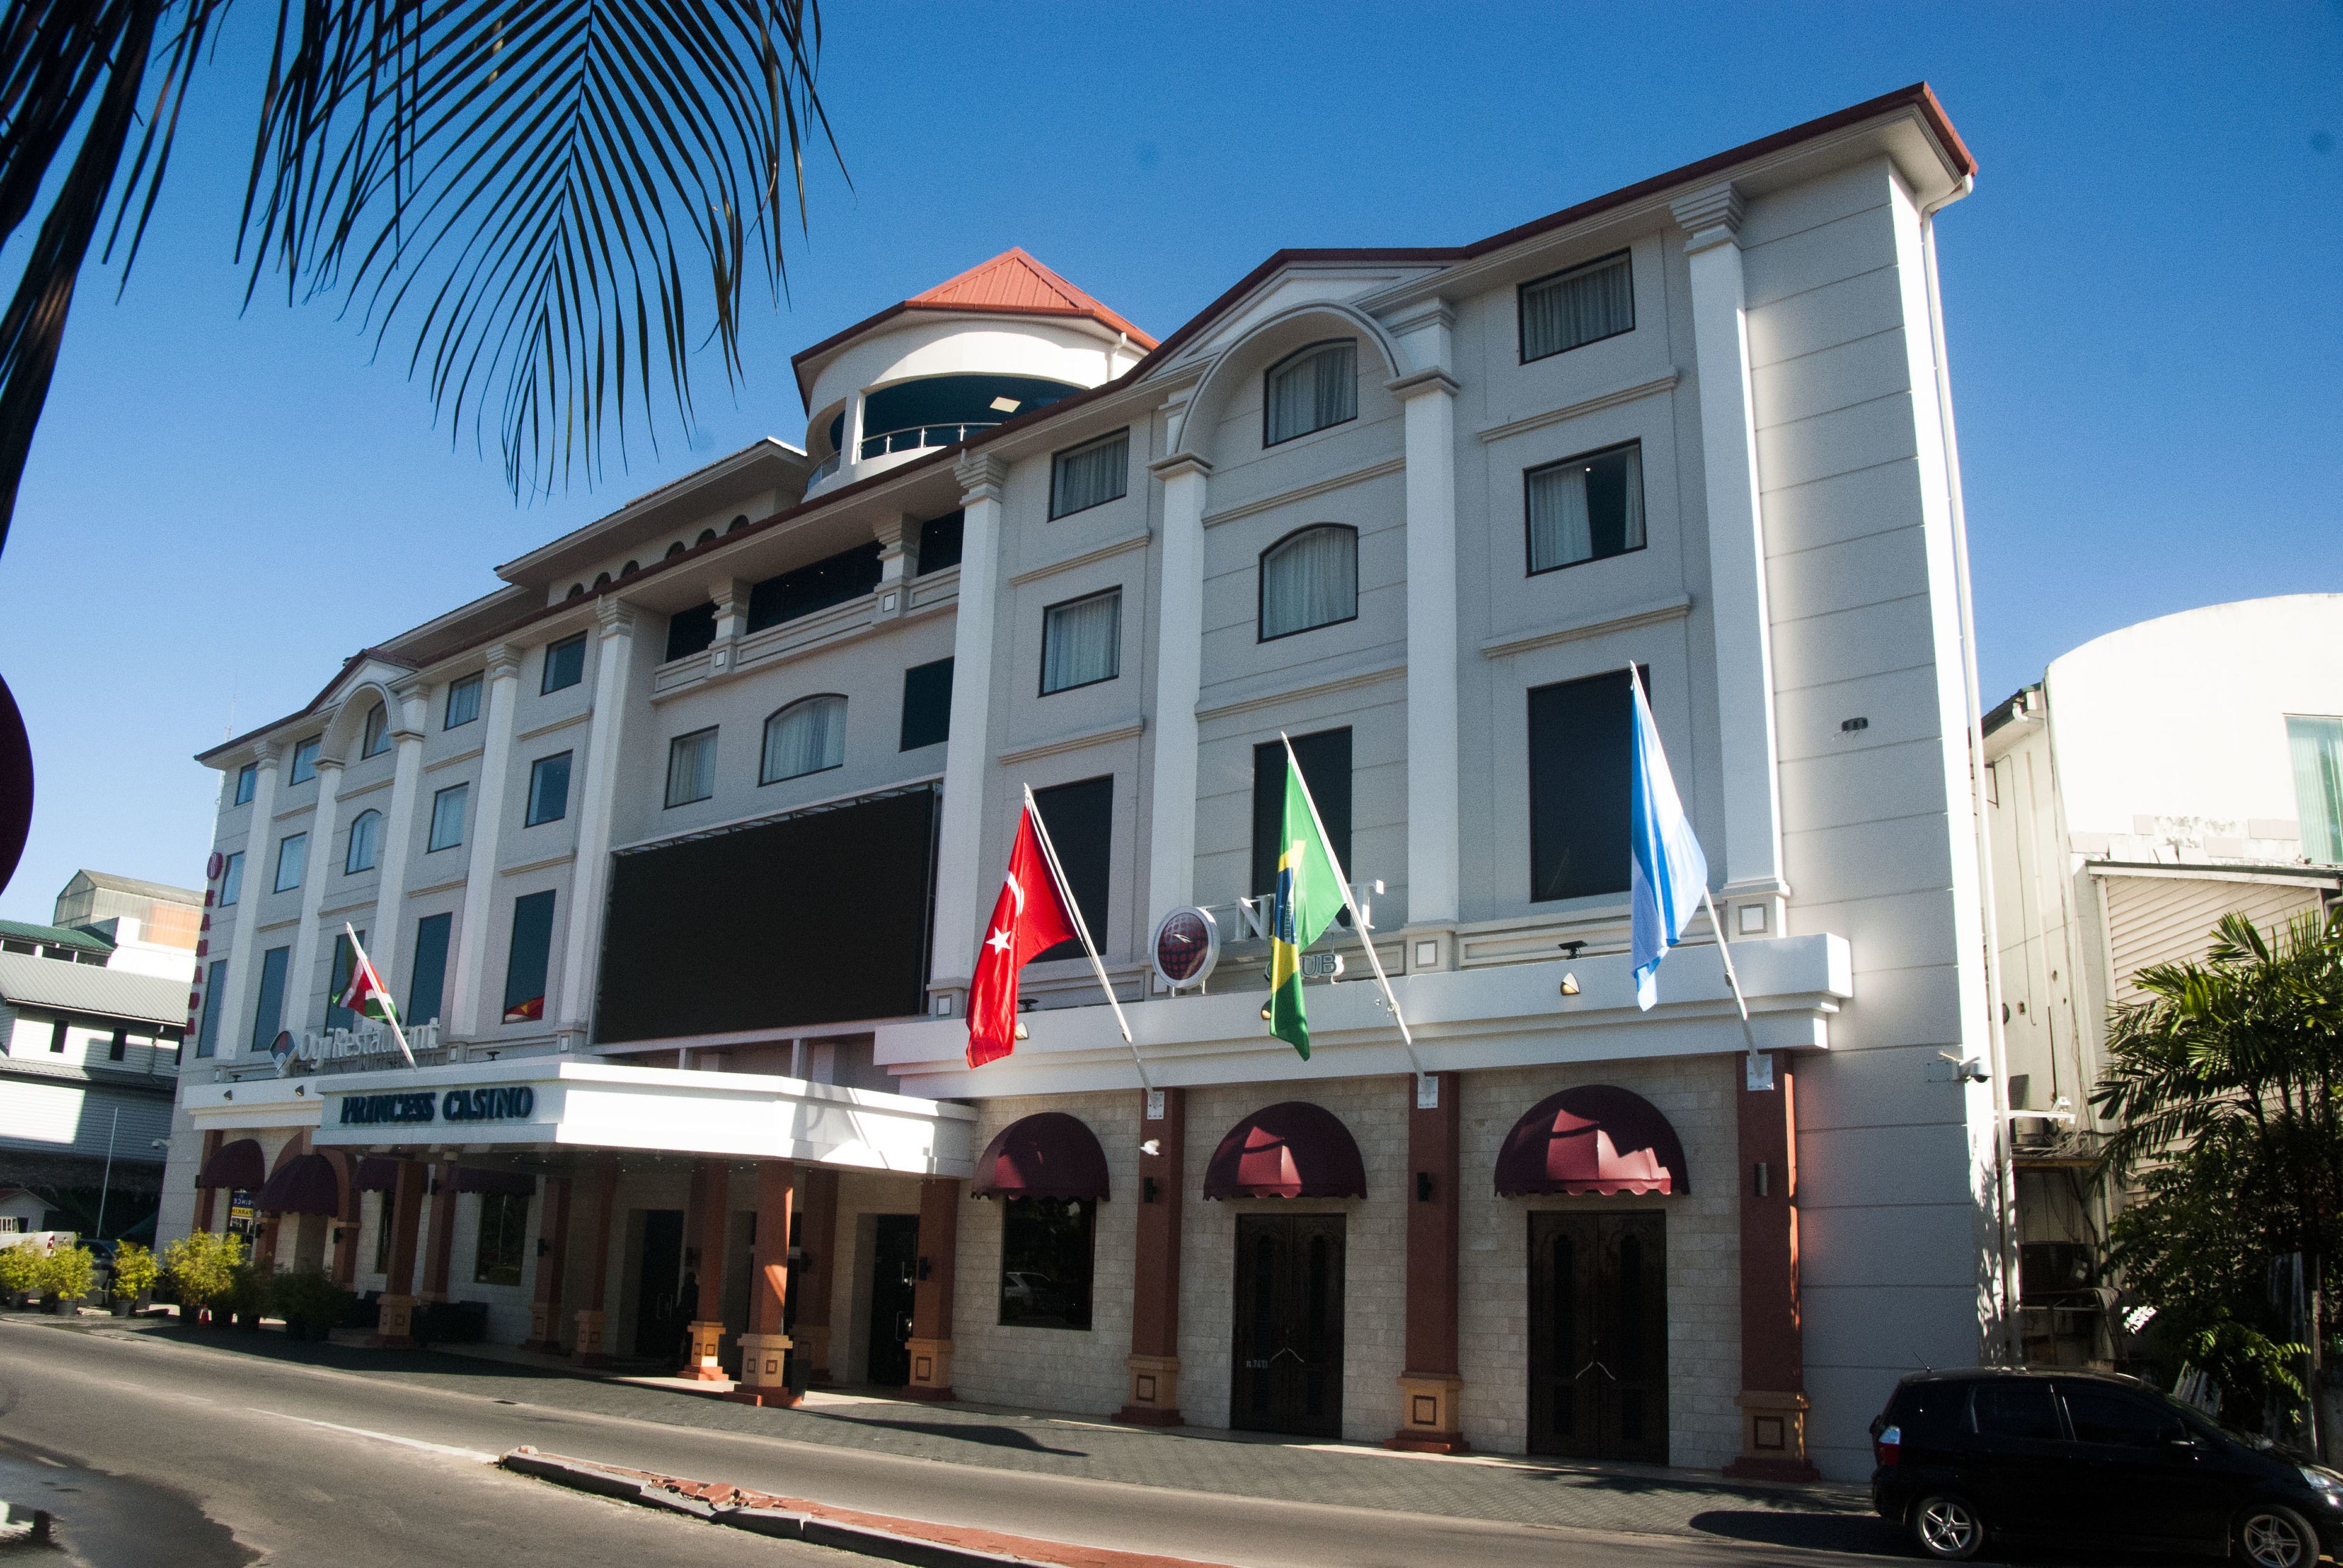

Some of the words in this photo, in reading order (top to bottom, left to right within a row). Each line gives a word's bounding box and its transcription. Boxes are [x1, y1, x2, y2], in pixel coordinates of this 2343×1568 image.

[184, 889, 215, 1035] RAMADA
[339, 1091, 436, 1123] PRINCESS
[442, 1086, 534, 1121] CASINO
